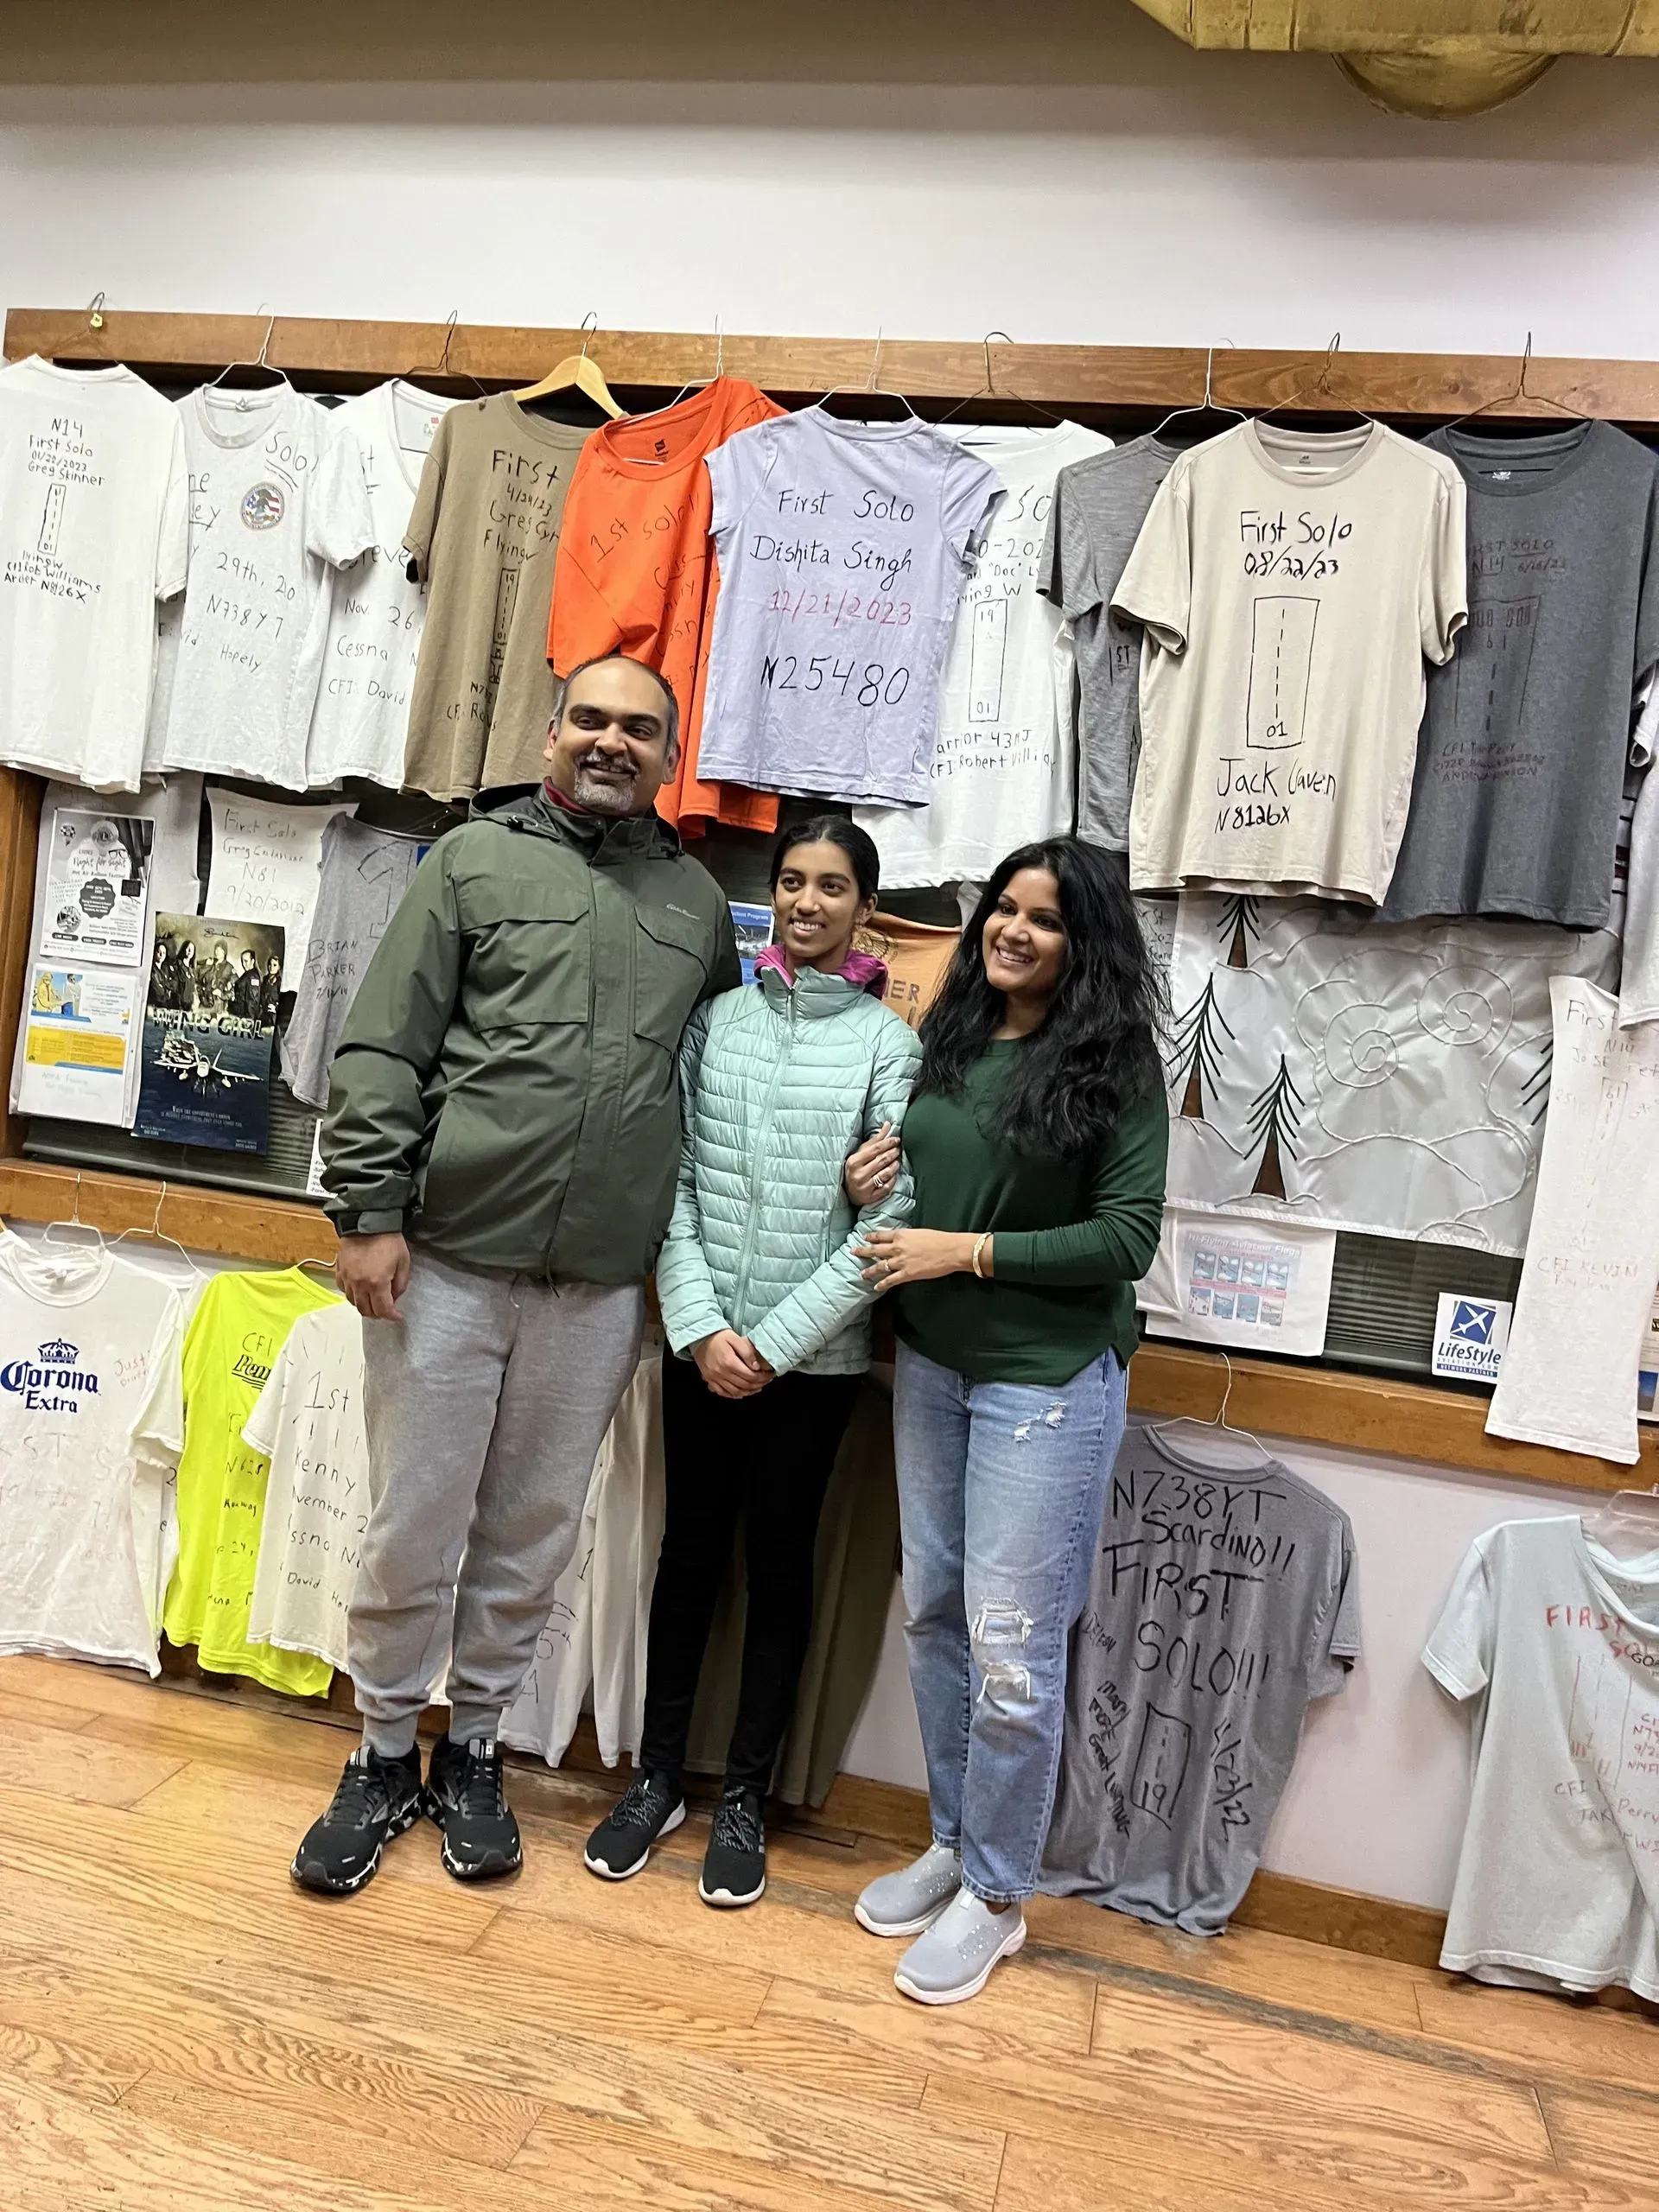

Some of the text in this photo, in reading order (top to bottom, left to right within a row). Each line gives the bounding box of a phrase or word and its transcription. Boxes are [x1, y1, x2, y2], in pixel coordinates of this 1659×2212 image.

[28, 460, 105, 486] Greg Skinner
[492, 449, 560, 490] First
[779, 489, 913, 522] First Solo
[1240, 511, 1353, 550] First Solo
[749, 535, 830, 572] Dishita
[843, 541, 912, 591] Singh
[1244, 545, 1340, 581] 08/22/23
[768, 588, 912, 627] 12/21/2023
[337, 634, 389, 661] Cessna
[367, 680, 406, 705] David
[760, 655, 910, 707] N25480
[1266, 721, 1288, 737] 01
[1217, 757, 1278, 797] Jack
[242, 1332, 273, 1357] CFI
[1438, 1342, 1502, 1365] LifeStyle
[0, 1360, 102, 1396] Corona
[25, 1389, 78, 1414] Extra
[1113, 1470, 1287, 1523] N738YT
[287, 1572, 321, 1589] David
[1103, 1540, 1265, 1621] FIRST
[1141, 1781, 1166, 1813] 19
